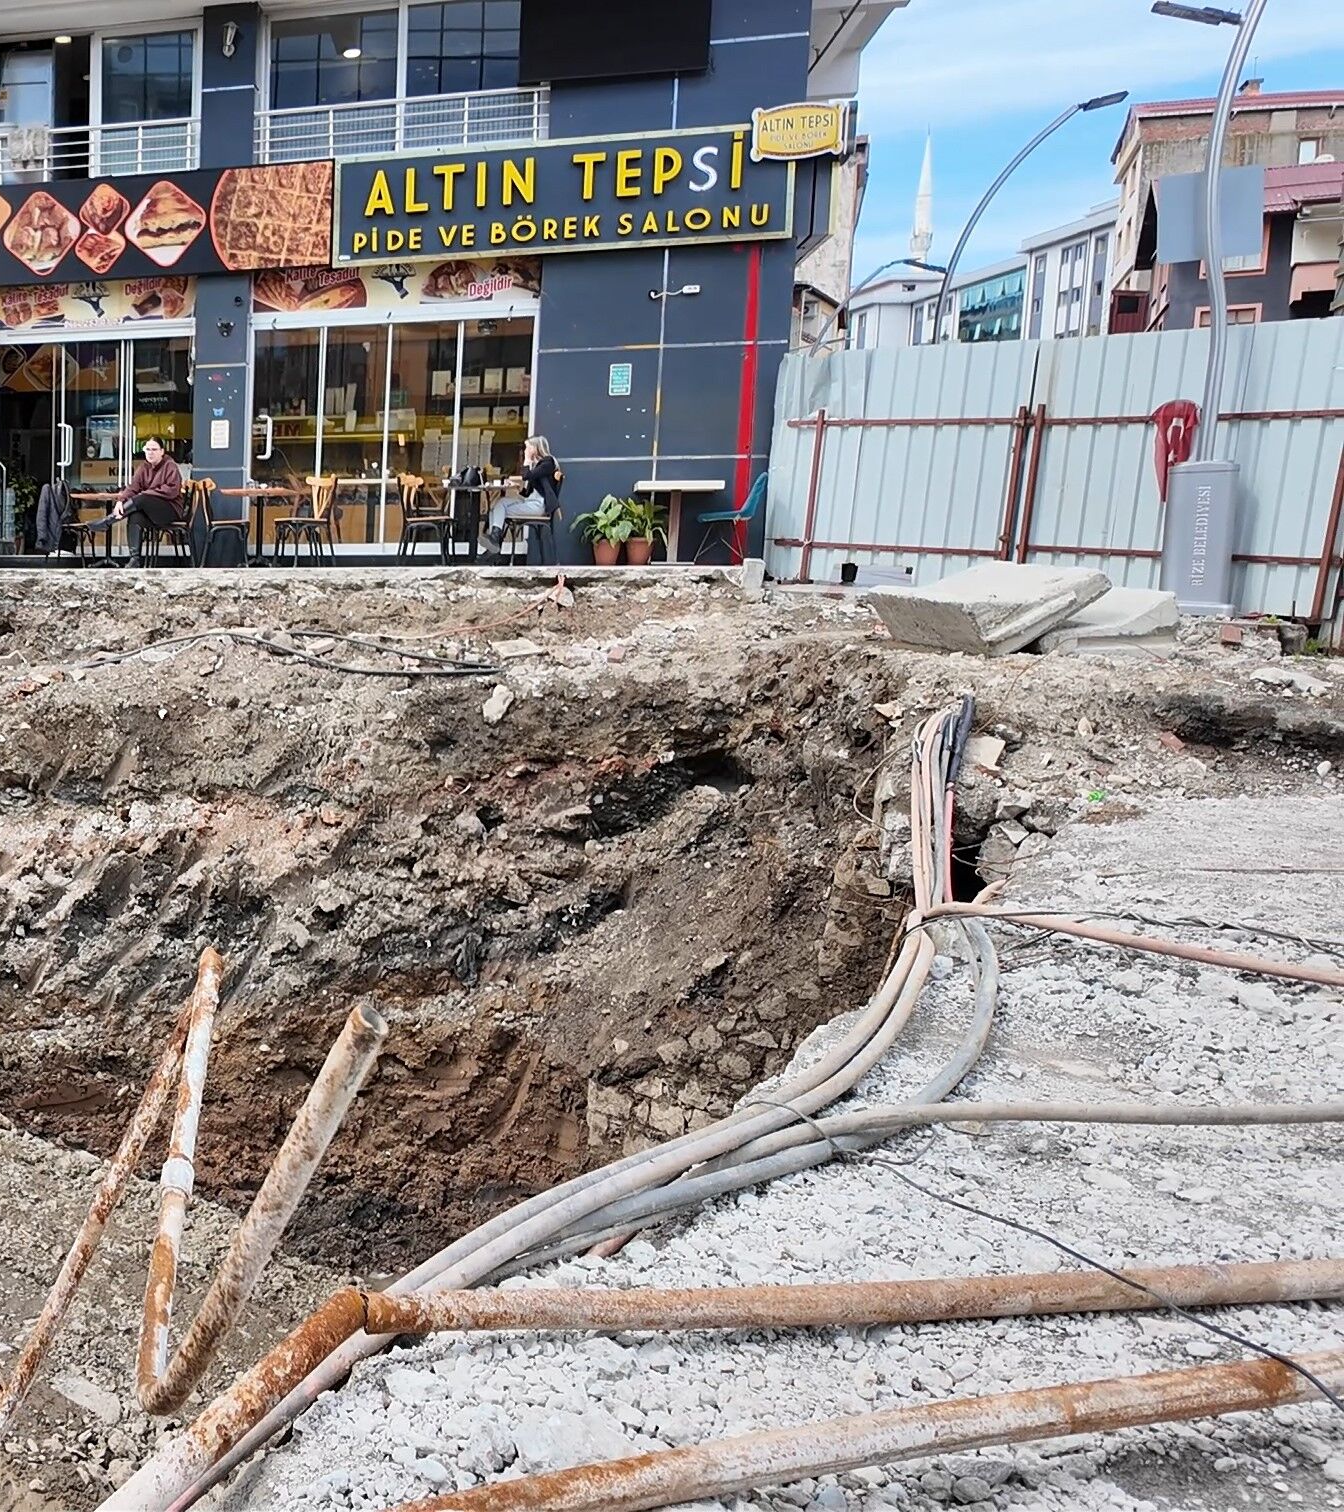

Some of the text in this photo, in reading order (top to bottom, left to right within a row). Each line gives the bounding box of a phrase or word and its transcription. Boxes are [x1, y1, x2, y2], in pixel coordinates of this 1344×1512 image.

[761, 117, 794, 133] ALTIN
[364, 130, 745, 217] ALTIN TEPSİ
[353, 203, 770, 254] PİDE VE BÖREK SALONU
[468, 276, 513, 299] Değildir
